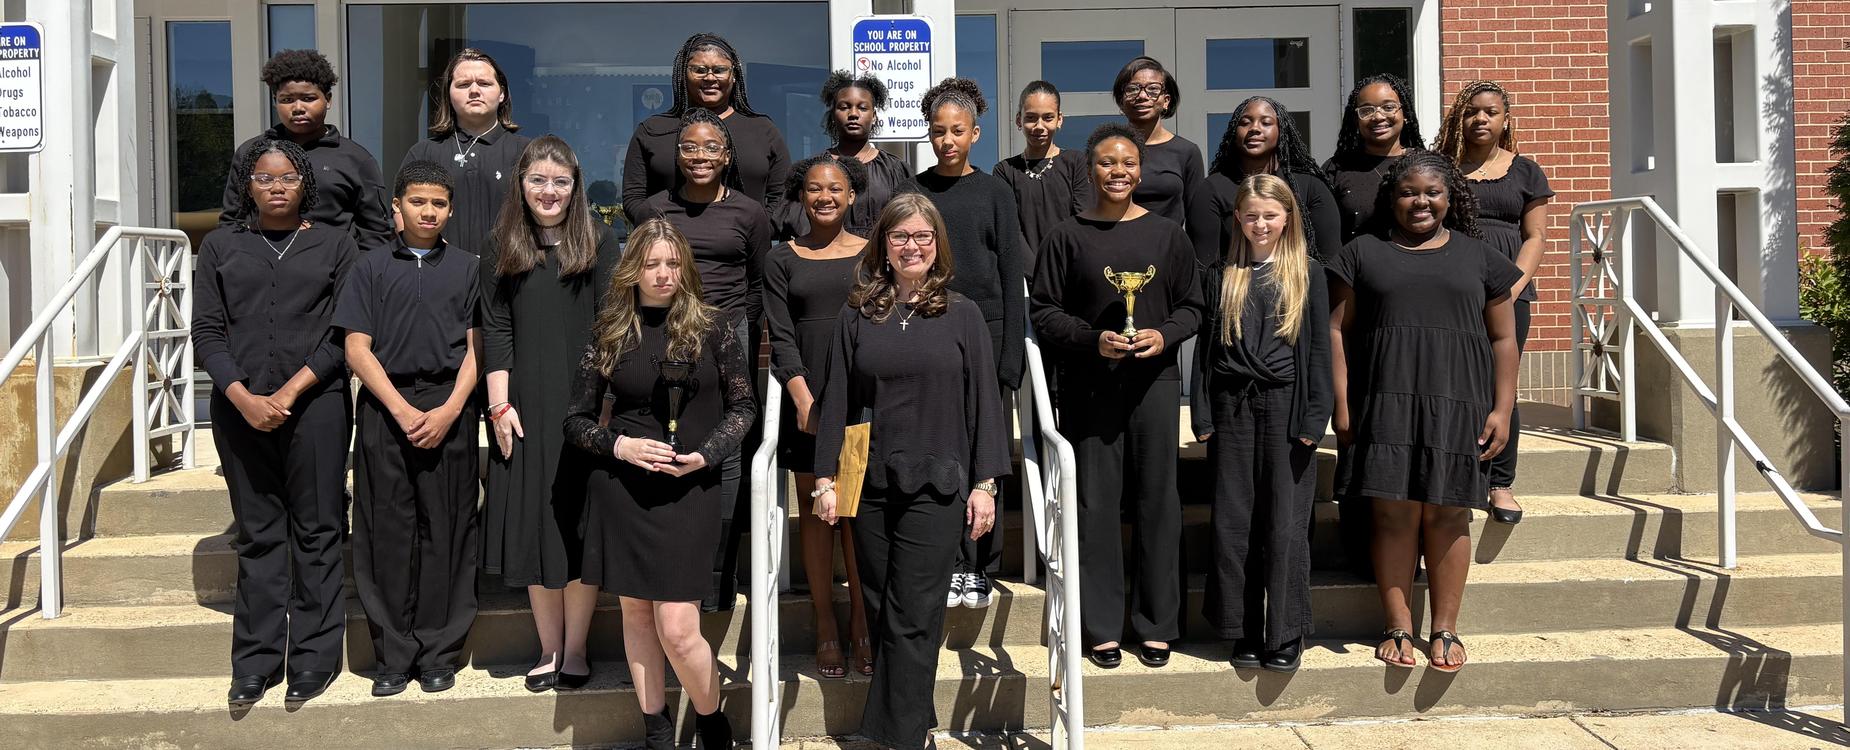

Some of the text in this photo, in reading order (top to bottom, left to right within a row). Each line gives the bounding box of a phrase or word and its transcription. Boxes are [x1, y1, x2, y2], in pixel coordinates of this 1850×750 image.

[867, 30, 917, 40] YOU ARE ON
[0, 36, 26, 47] RE ON
[854, 41, 930, 52] SCHOOL PROPERTY
[871, 59, 922, 70] No Alcohol
[0, 66, 31, 78] lcohol
[887, 78, 914, 92] Drugs
[888, 97, 921, 108] Tobacc
[888, 116, 929, 130] Weapons
